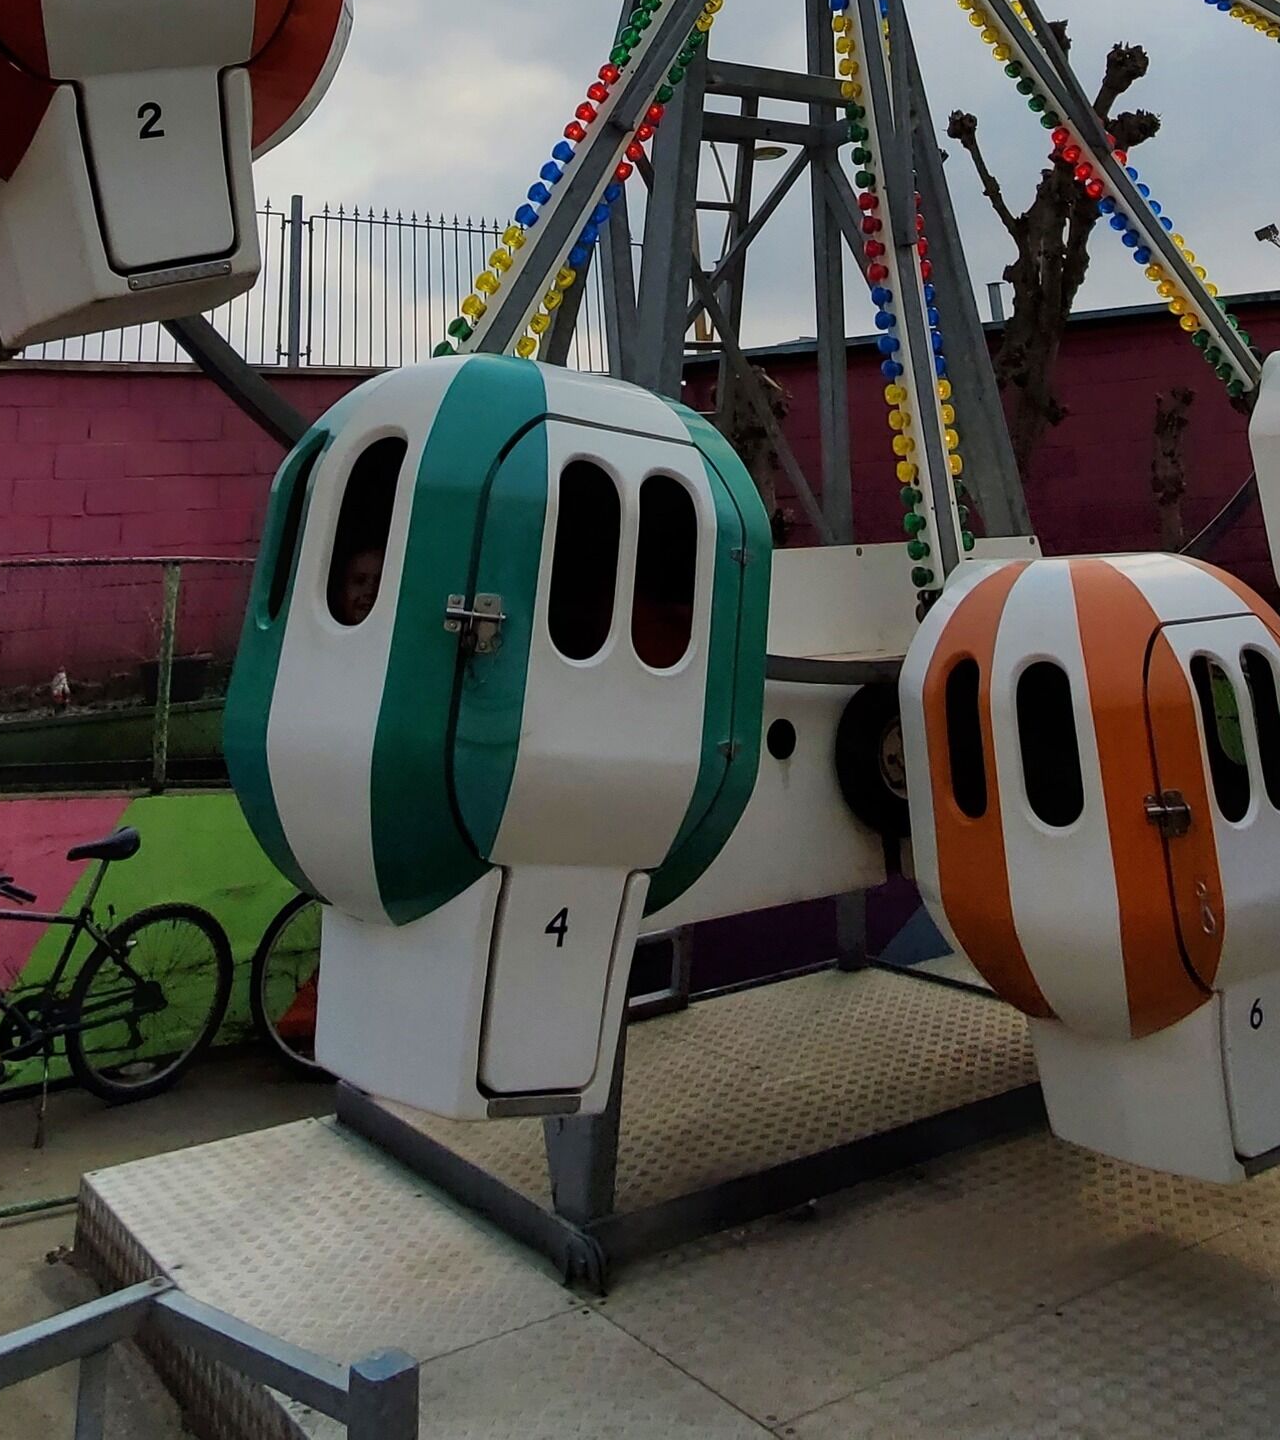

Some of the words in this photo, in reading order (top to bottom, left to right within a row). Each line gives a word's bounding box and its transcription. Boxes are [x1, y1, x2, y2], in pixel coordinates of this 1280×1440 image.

[137, 101, 165, 140] 2
[544, 906, 569, 948] 4
[1250, 997, 1263, 1030] 6
